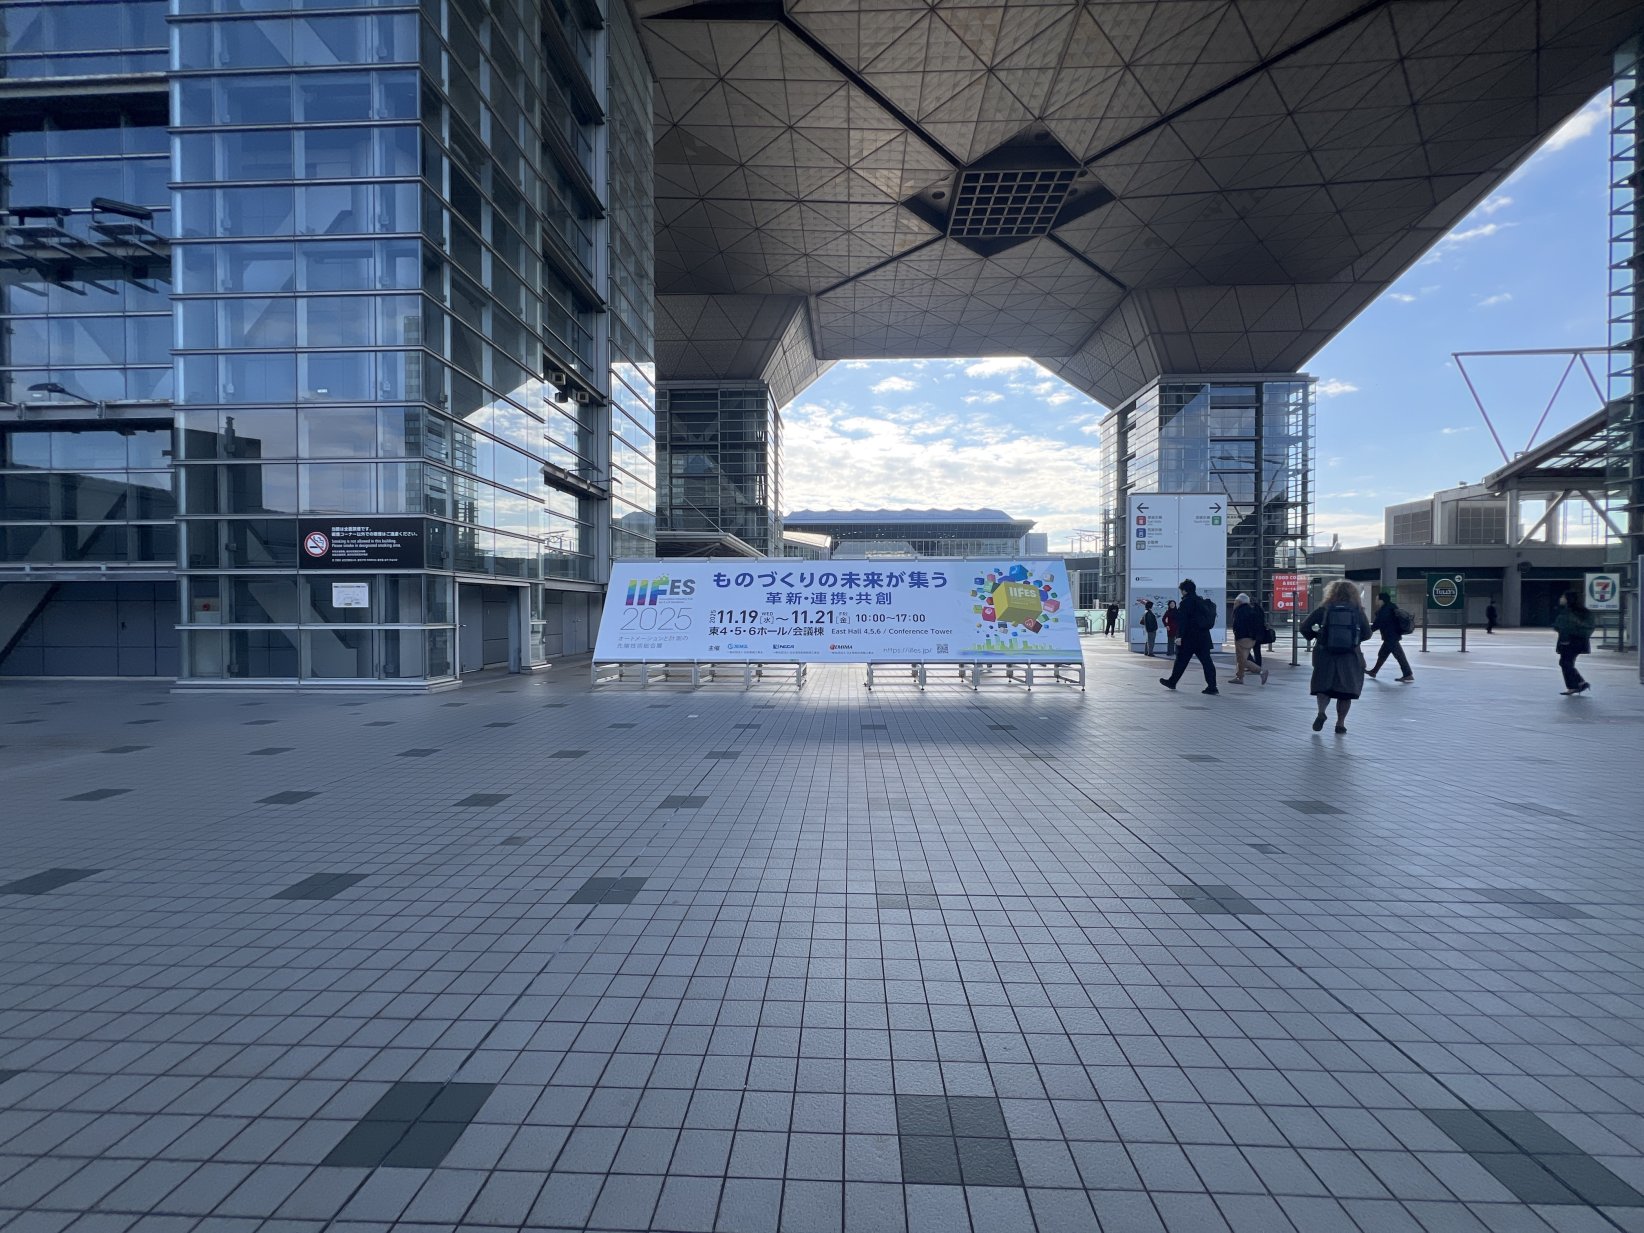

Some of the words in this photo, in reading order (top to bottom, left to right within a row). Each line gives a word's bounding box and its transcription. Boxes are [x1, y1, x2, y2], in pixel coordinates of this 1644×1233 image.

[713, 571, 947, 588] ものづくりの未来が集う
[625, 575, 696, 606] IIFES
[620, 607, 693, 631] 2025
[717, 610, 759, 624] 11.19
[791, 610, 834, 624] 11.21
